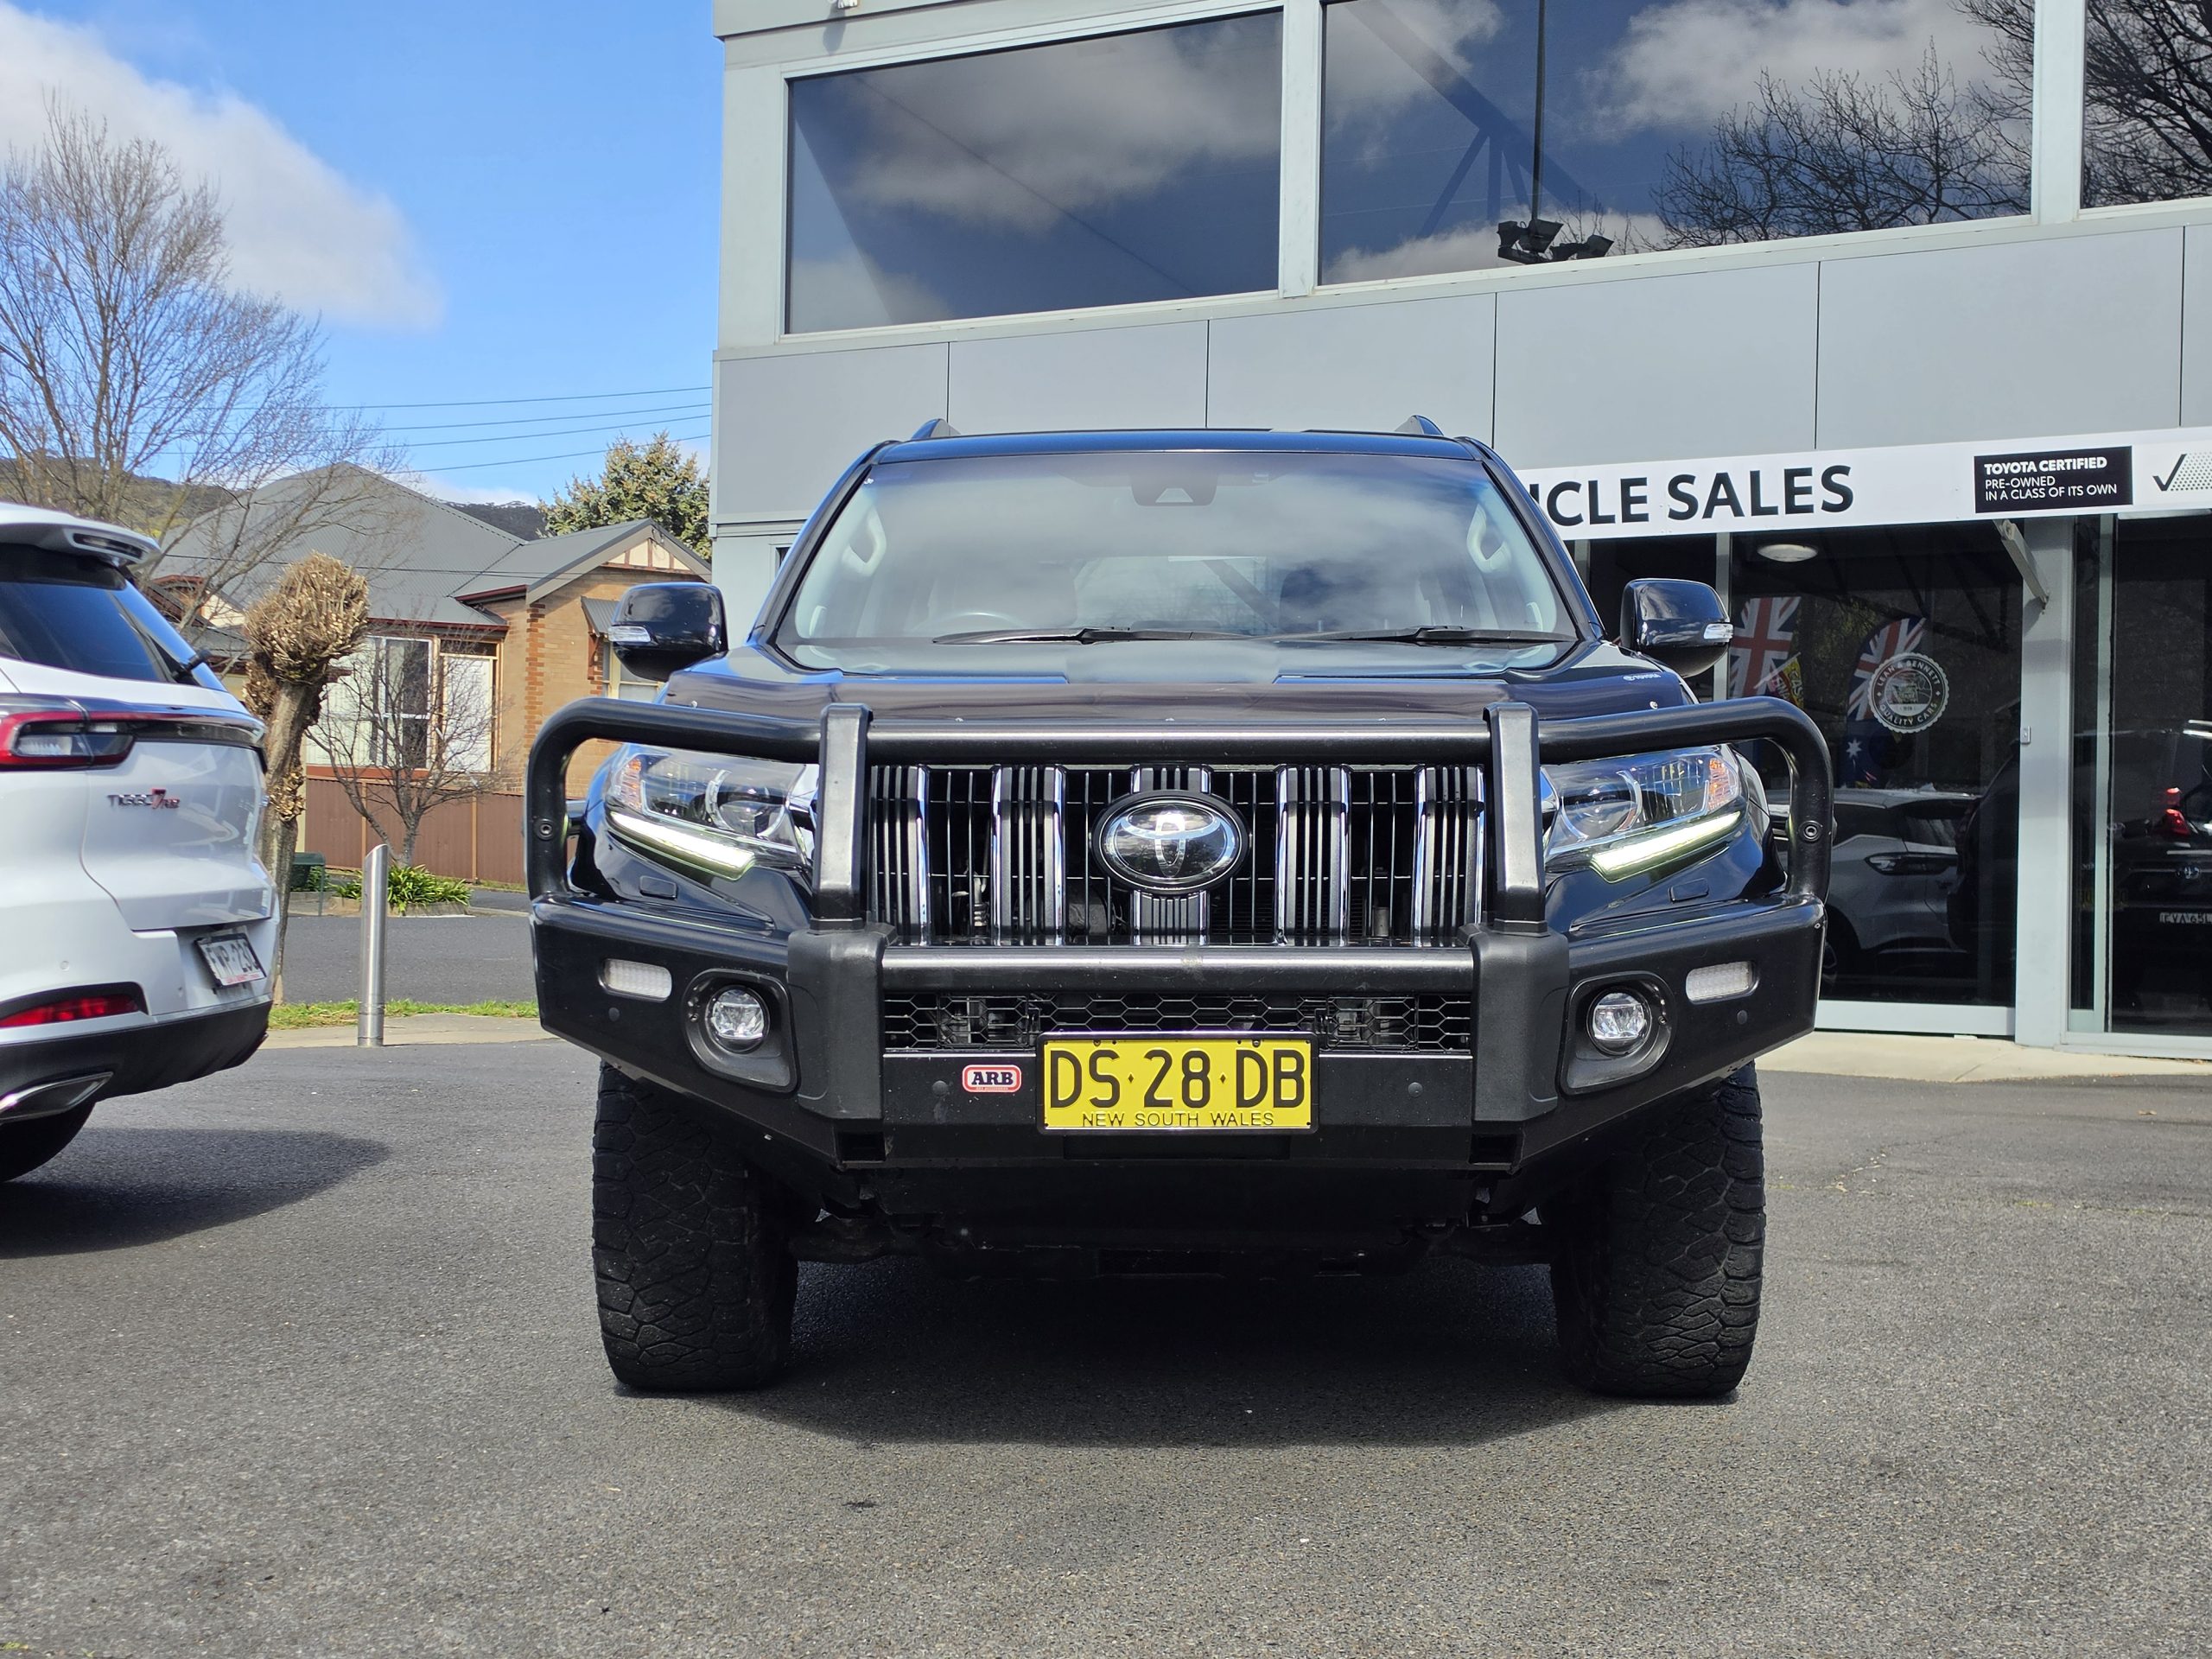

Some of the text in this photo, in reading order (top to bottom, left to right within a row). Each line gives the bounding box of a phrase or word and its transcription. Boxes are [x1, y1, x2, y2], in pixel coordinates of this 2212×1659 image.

[1984, 456, 2107, 475] TOYOTA CERTIFIED
[1985, 475, 2056, 490] PRE-OWNED
[1667, 464, 1854, 521] SALES
[1985, 483, 2118, 501] IN A CLASS OF ITS OWN
[1877, 665, 1896, 687] LEAN
[1905, 659, 1941, 685] BENNETT
[1879, 702, 1937, 726] QUALITY CARS
[971, 1071, 1014, 1085] ARB
[1082, 1111, 1274, 1127] NEW SOUTH WALES
